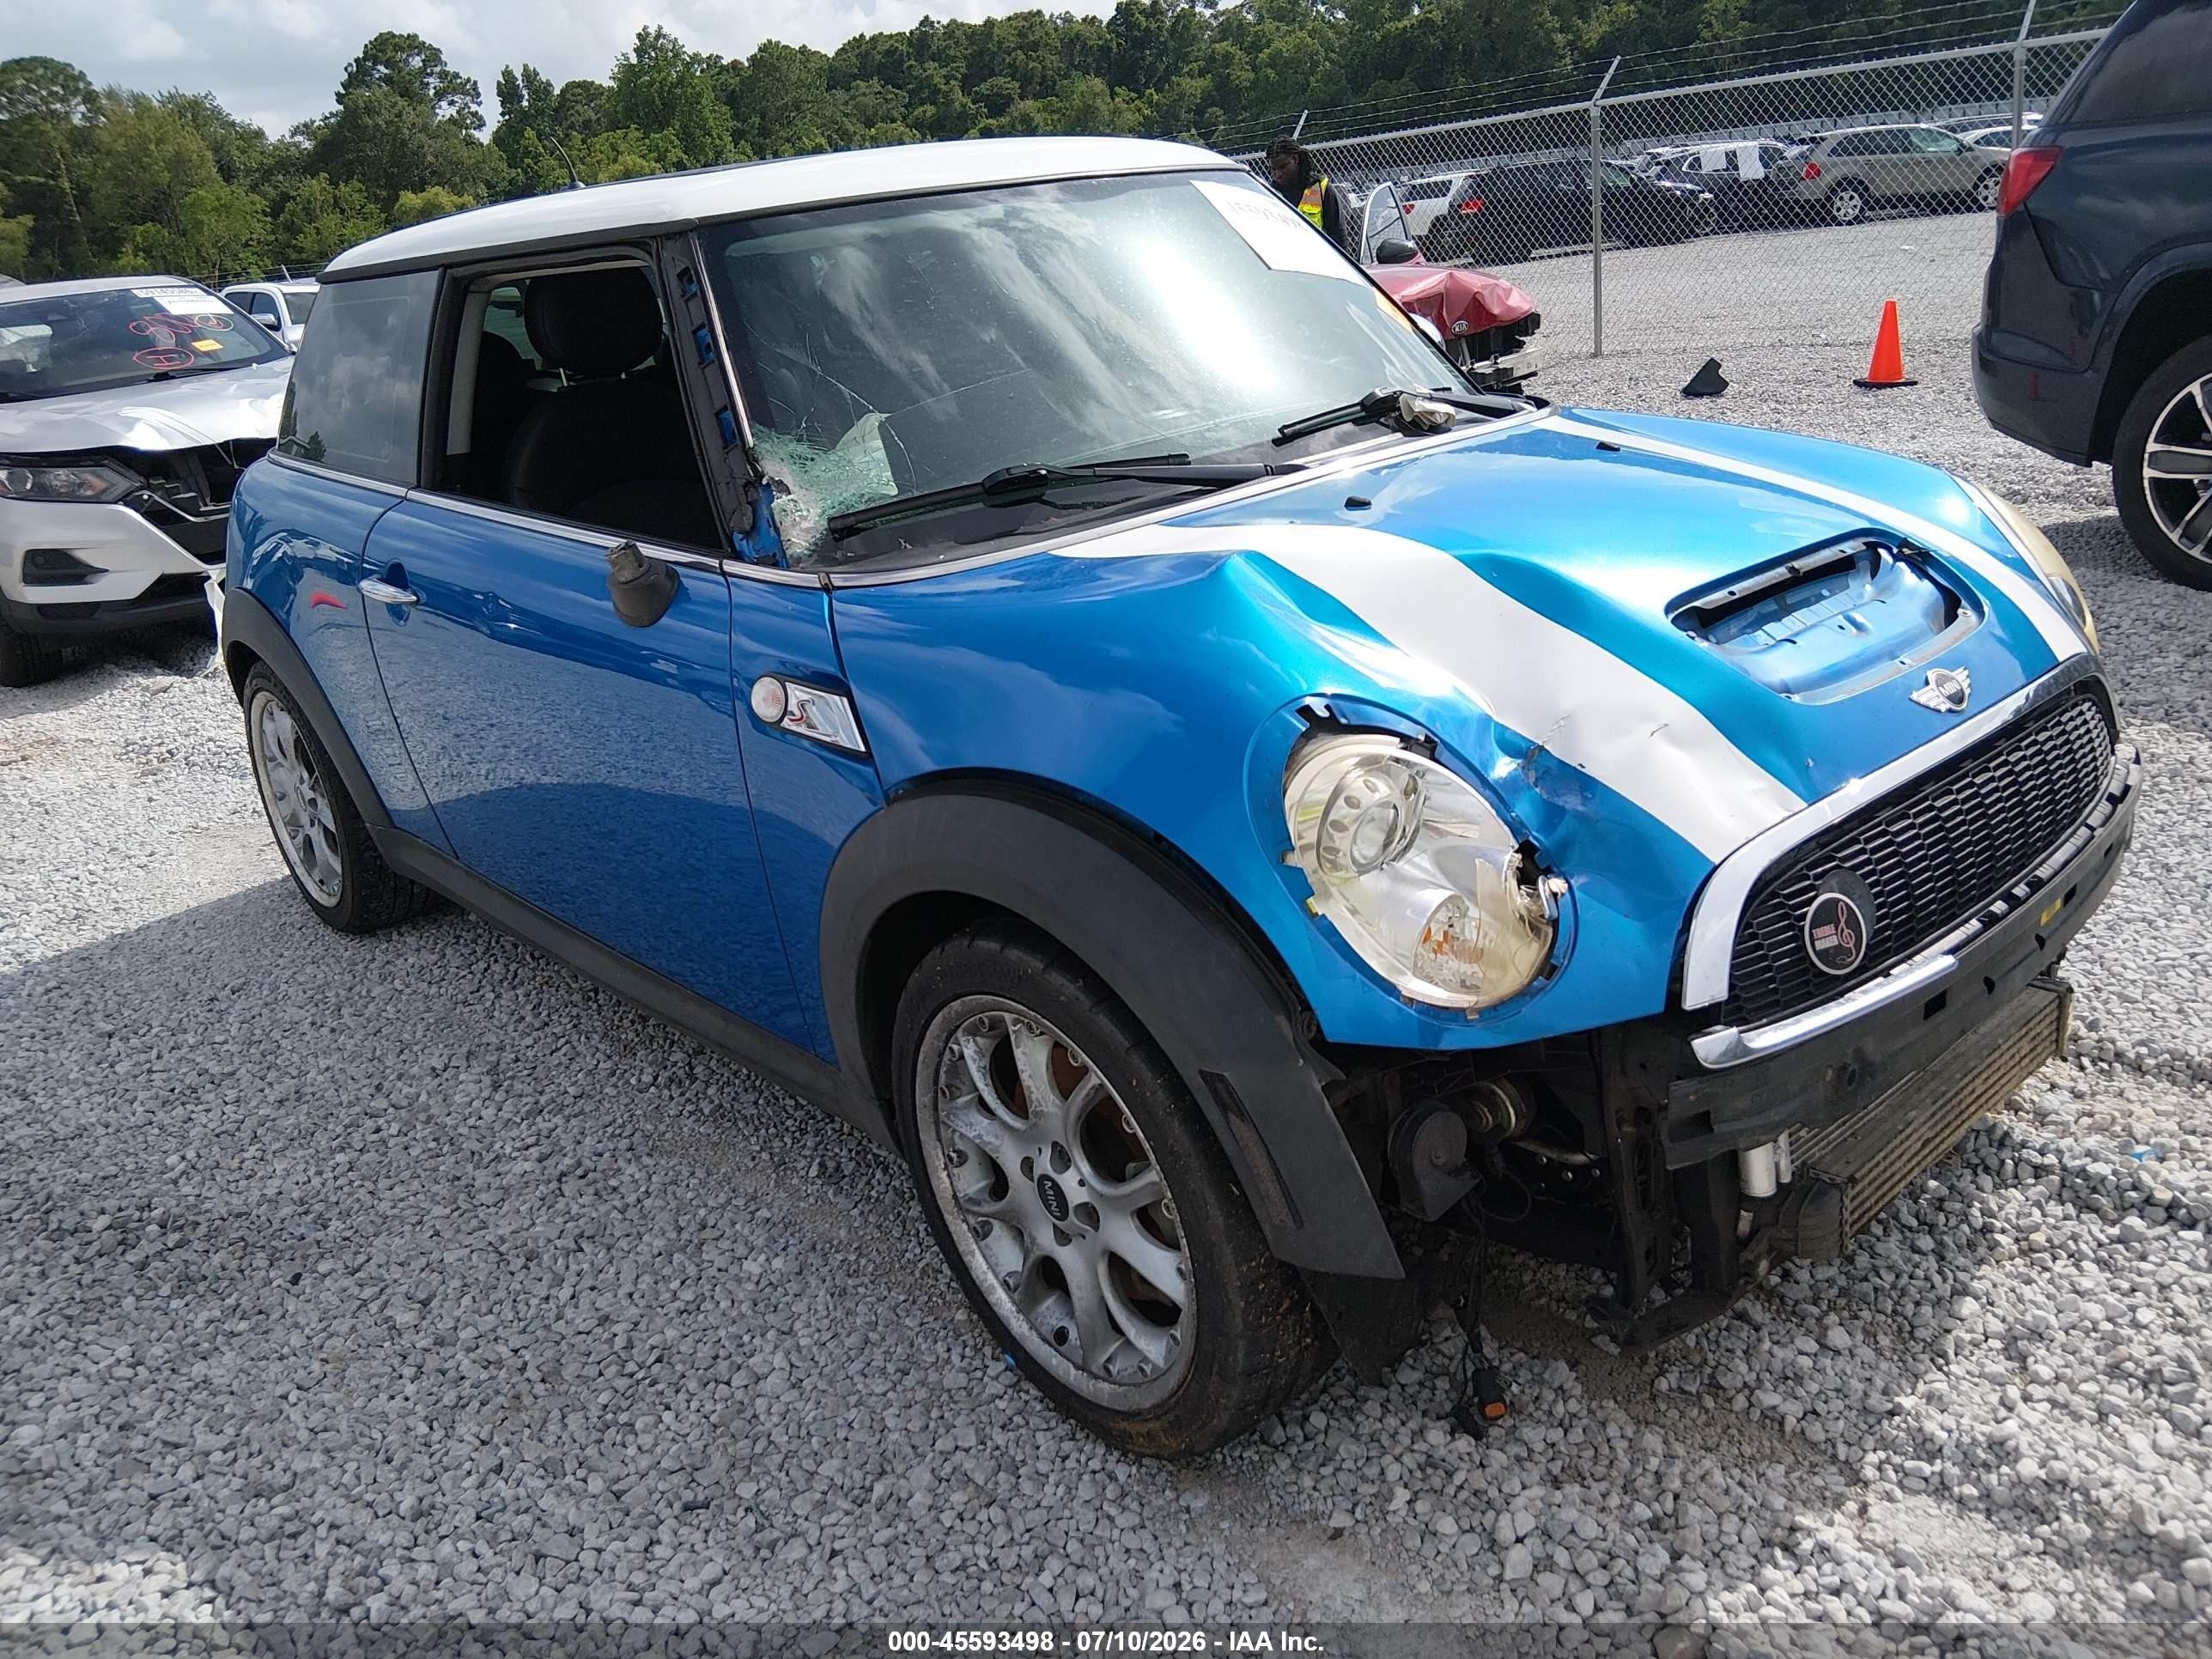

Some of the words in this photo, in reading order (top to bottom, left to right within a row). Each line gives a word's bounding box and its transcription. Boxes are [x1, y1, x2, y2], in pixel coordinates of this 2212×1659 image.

[1455, 323, 1468, 333] KIA
[1937, 678, 1962, 697] MINI
[1812, 923, 1836, 939] TREBLE
[1043, 1180, 1061, 1217] MINI
